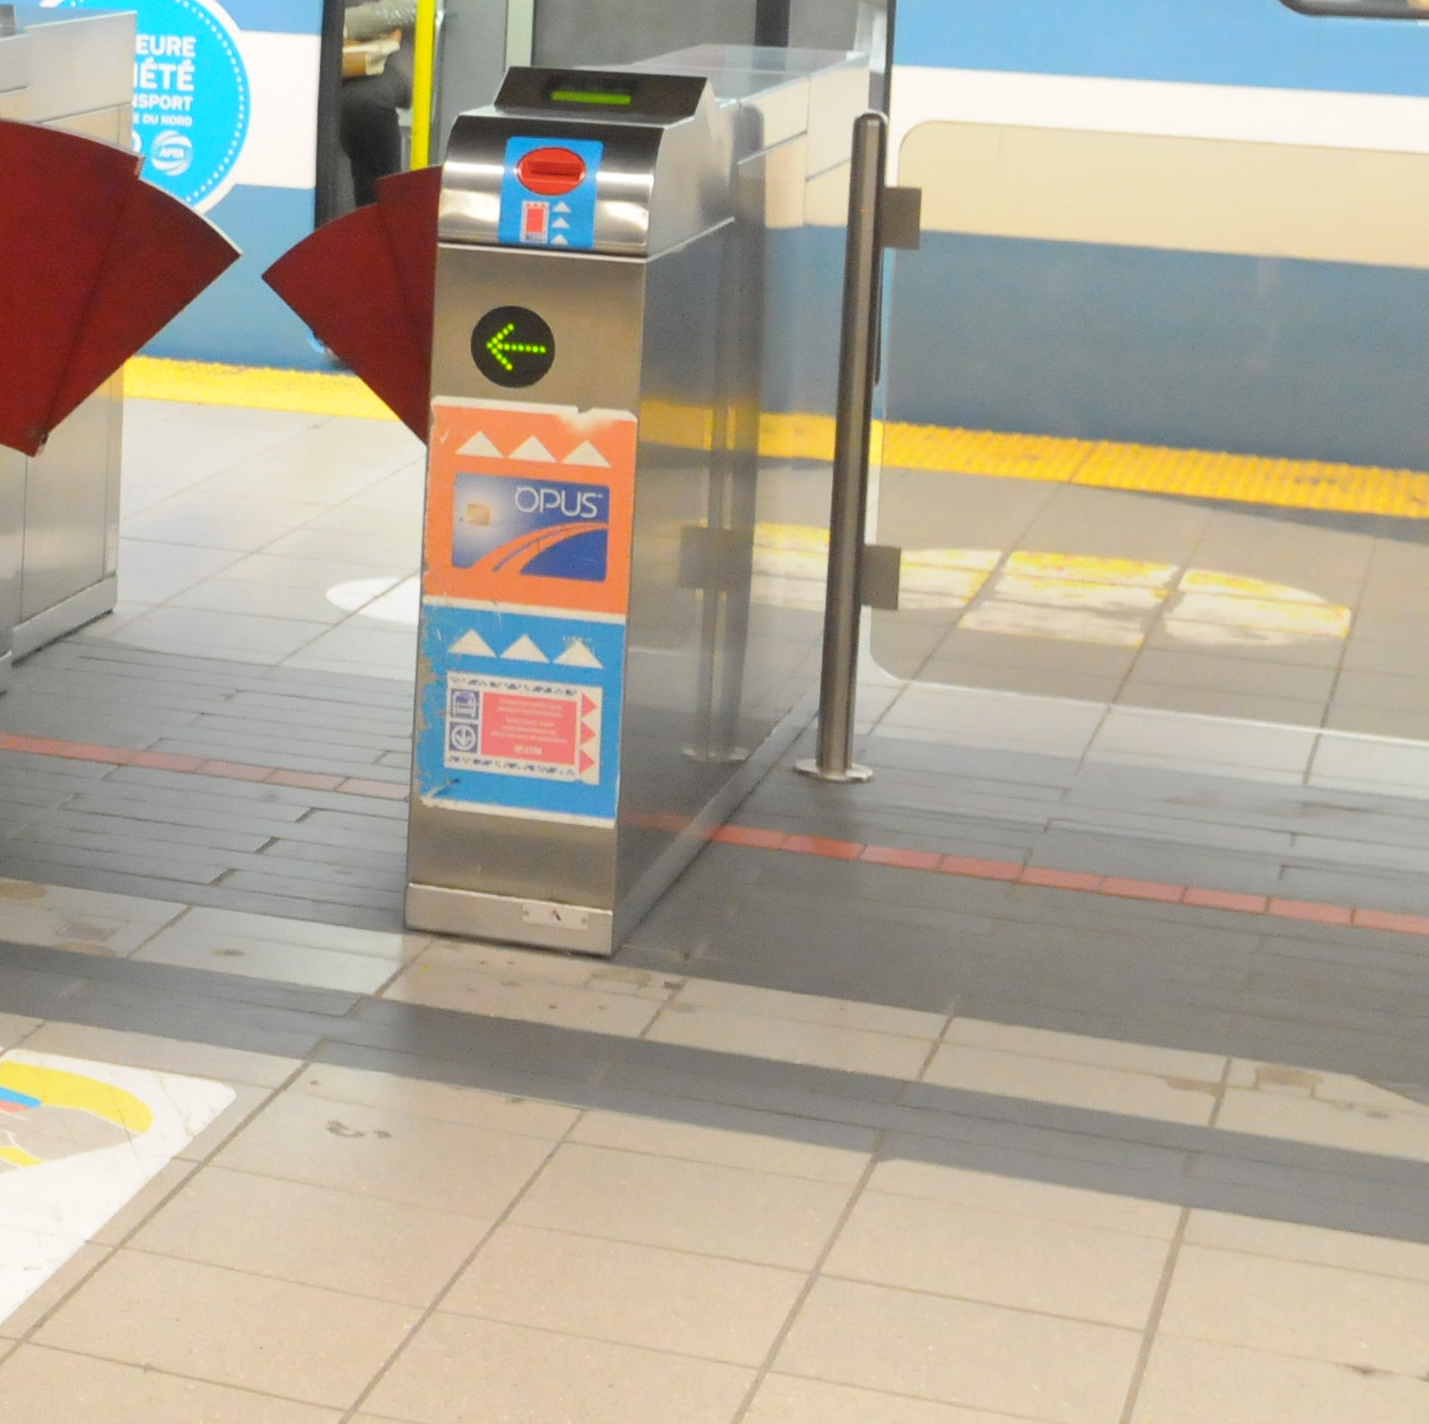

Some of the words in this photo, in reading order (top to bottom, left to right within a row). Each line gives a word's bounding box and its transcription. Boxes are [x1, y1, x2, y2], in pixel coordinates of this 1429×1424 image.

[143, 114, 159, 125] DU
[161, 114, 193, 127] NORD
[514, 486, 599, 519] OPUS
